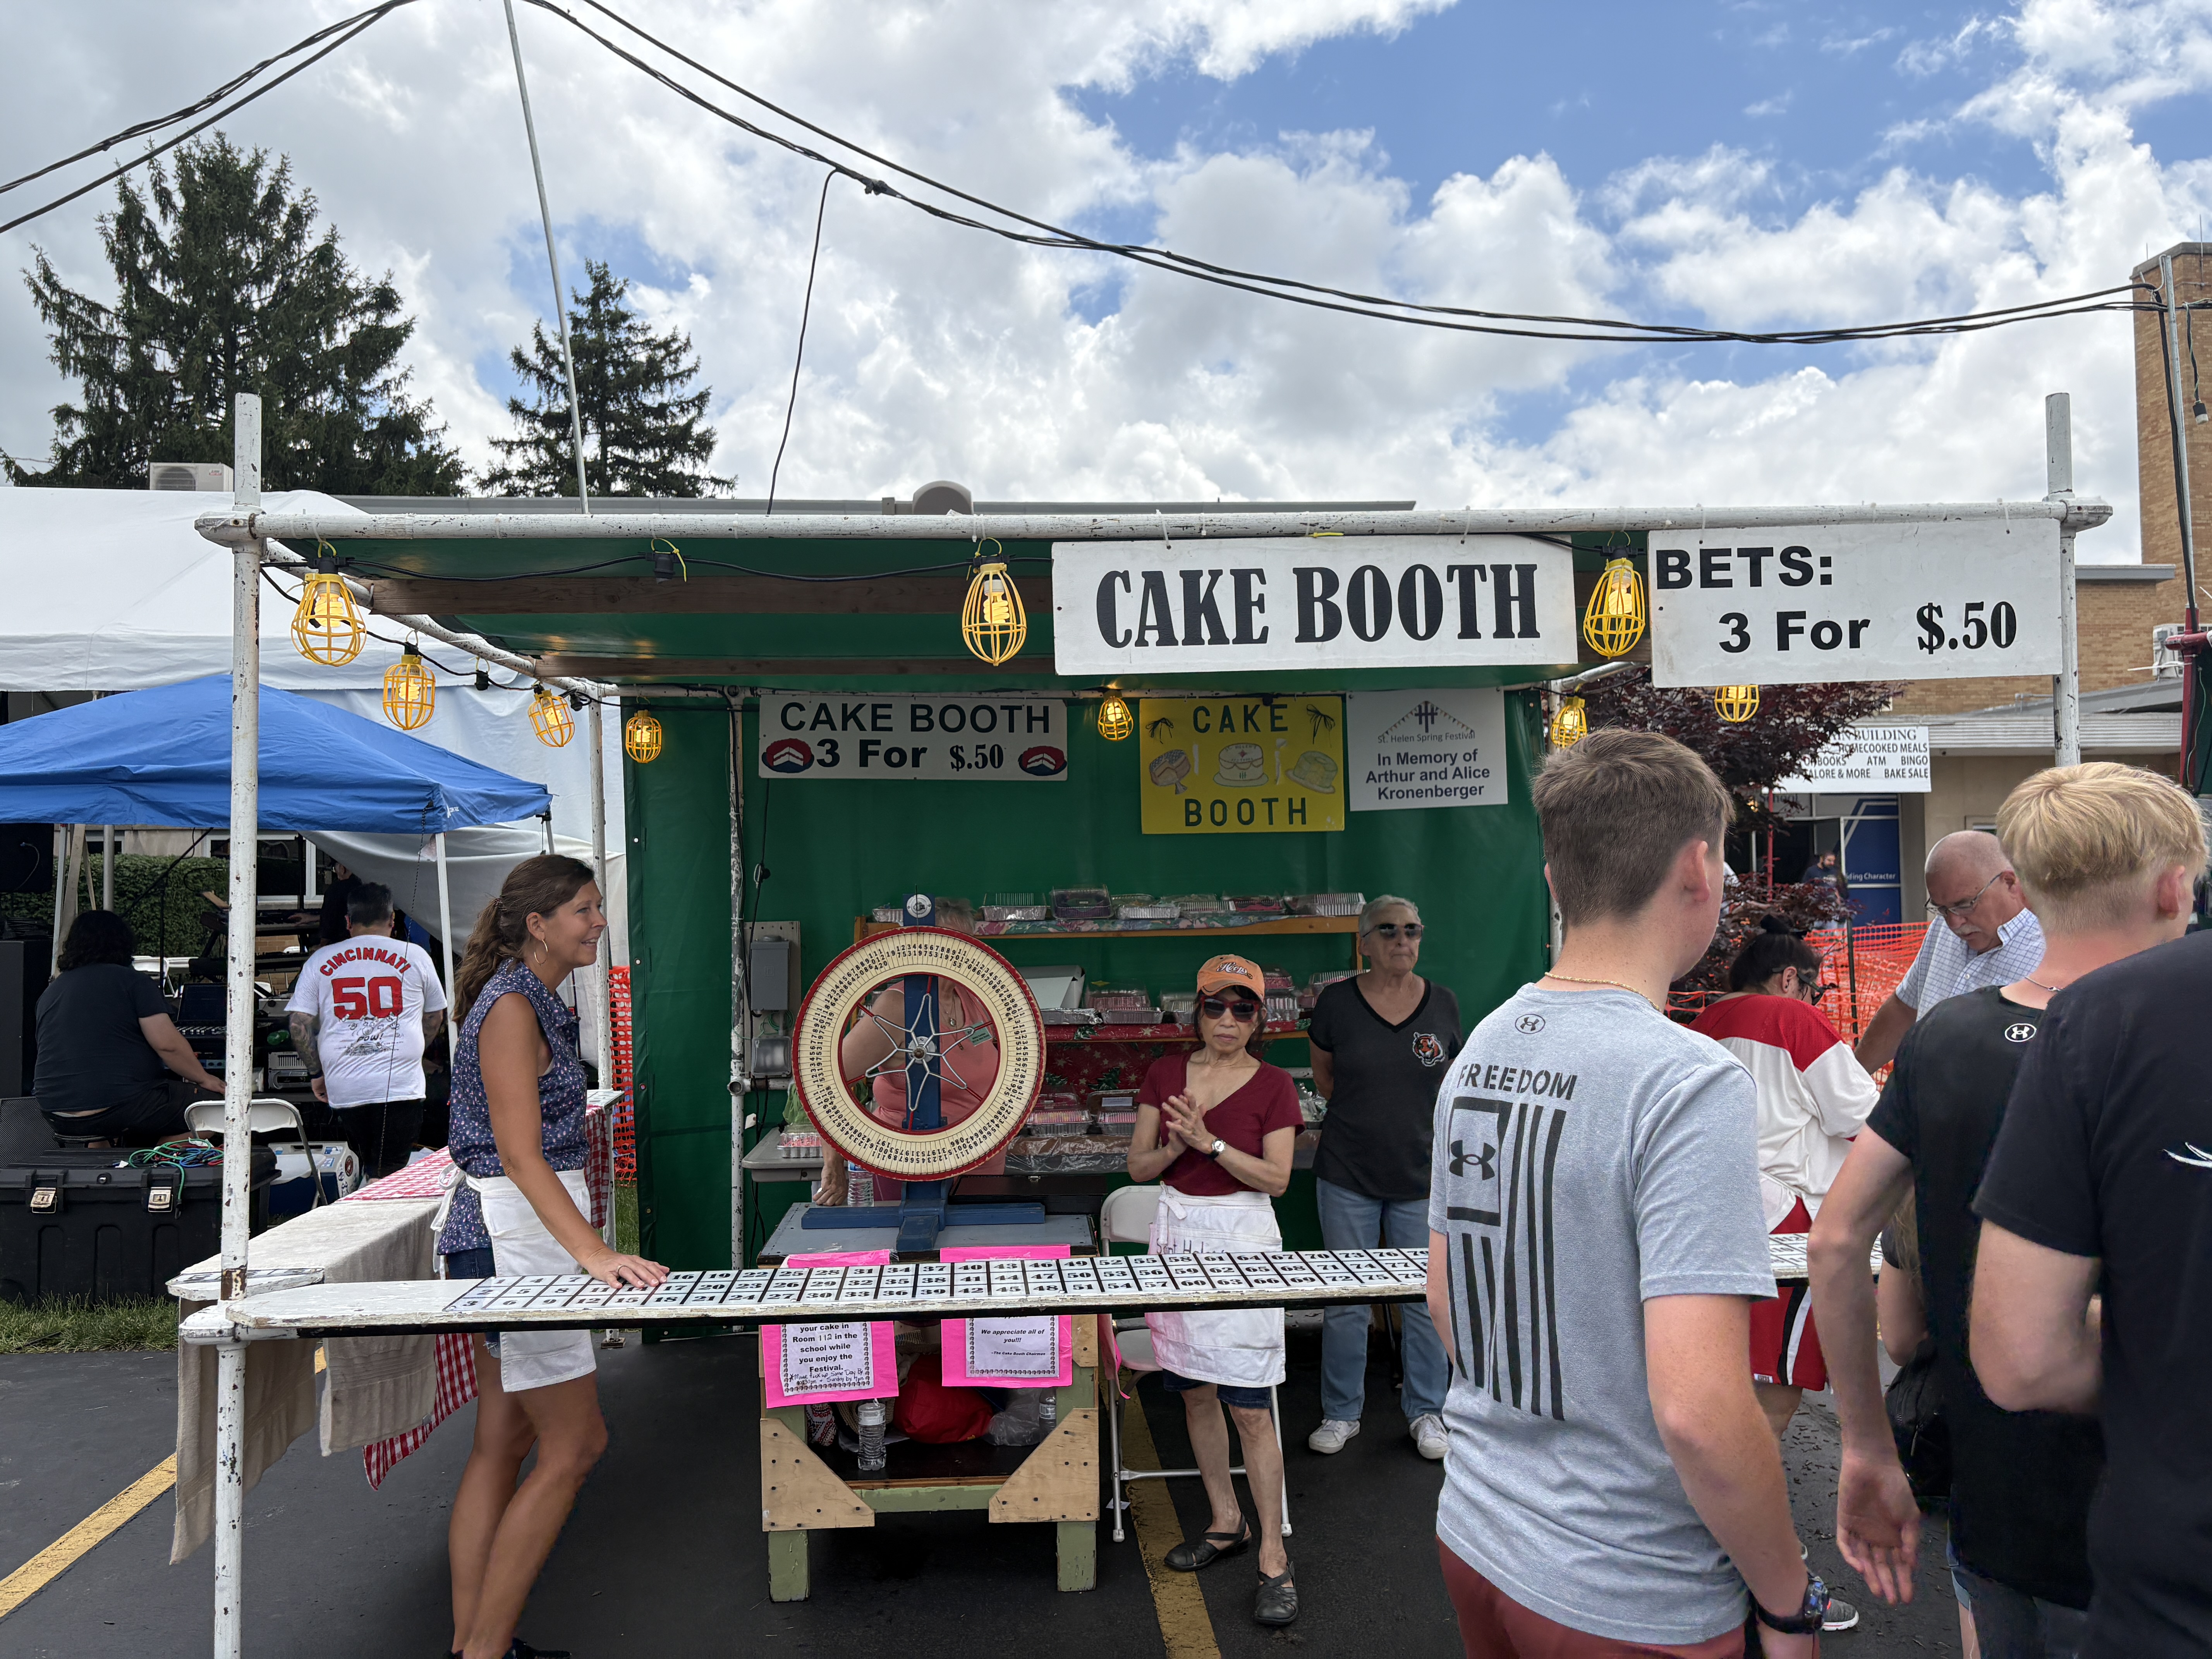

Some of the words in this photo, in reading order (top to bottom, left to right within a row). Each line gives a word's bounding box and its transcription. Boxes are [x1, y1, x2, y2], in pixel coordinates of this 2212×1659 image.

[1656, 545, 1832, 589] BETS:
[1096, 568, 1269, 649] CAKE
[1292, 563, 1540, 643] BOOTH
[1718, 612, 1751, 653] 3
[1776, 611, 1870, 651] For
[1916, 601, 2017, 654] $.50
[780, 702, 893, 731] CAKE
[910, 704, 1050, 733] BOOTH
[1193, 704, 1288, 733] CAKE
[1417, 733, 1443, 743] Spring
[1445, 730, 1475, 740] Festival
[1839, 743, 1898, 753] HOMECOOKED
[1900, 743, 1927, 753] MEALS
[1855, 729, 1917, 741] BUILDING
[816, 738, 840, 768] 3
[859, 739, 927, 768] For
[950, 744, 1004, 771] $.50
[1377, 753, 1391, 766] In
[1396, 752, 1457, 766] Memory
[1463, 748, 1478, 762] of
[1867, 756, 1886, 766] ATM
[1901, 755, 1928, 766] BINGO
[1366, 770, 1415, 783] Arthur
[1420, 767, 1448, 781] and
[1452, 766, 1490, 780] Alice
[1809, 768, 1836, 779] ALORE
[1838, 768, 1844, 778] &
[1846, 768, 1870, 779] MORE
[1884, 768, 1906, 779] BAKE
[1908, 768, 1929, 779] SALE
[1378, 785, 1484, 800] Kronenberger
[1185, 797, 1306, 826] BOOTH
[319, 947, 412, 976] CINCINNATI
[331, 976, 403, 1020] 50
[357, 1033, 384, 1042] POW!
[1457, 1063, 1578, 1101] FREEDOM
